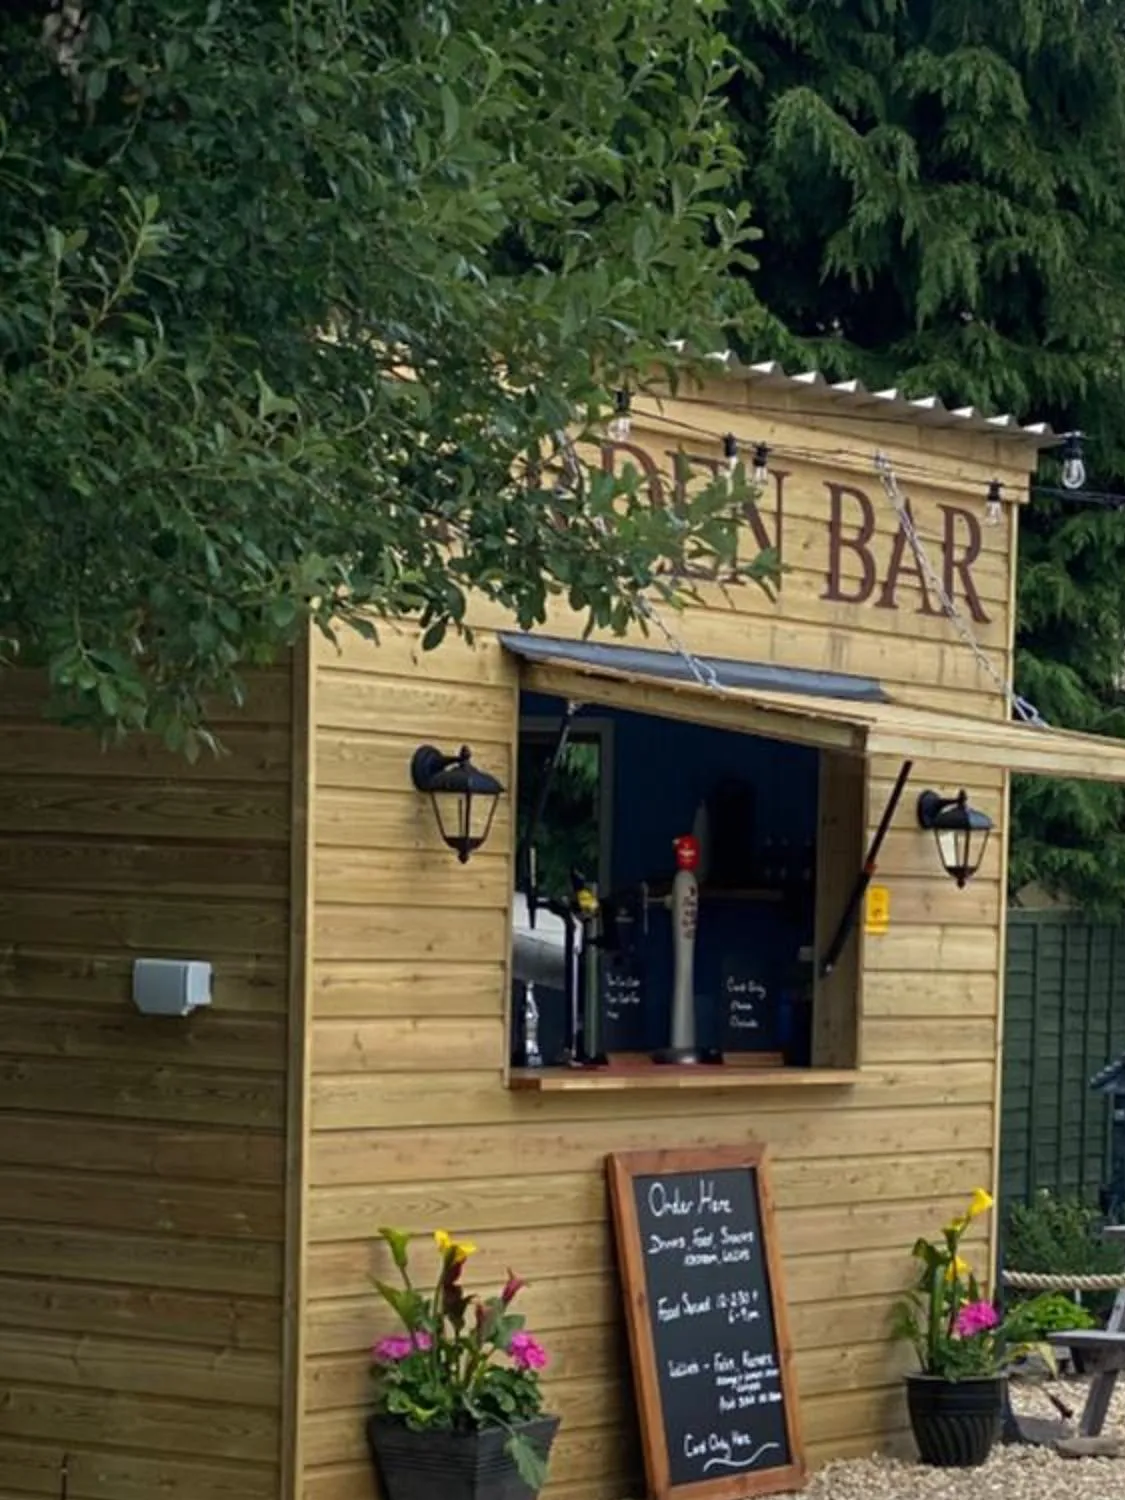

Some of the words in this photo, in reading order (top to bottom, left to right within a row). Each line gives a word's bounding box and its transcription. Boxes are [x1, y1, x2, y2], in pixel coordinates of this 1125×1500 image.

[819, 480, 992, 624] BAR
[648, 1182, 695, 1217] Order
[697, 1179, 733, 1214] Here
